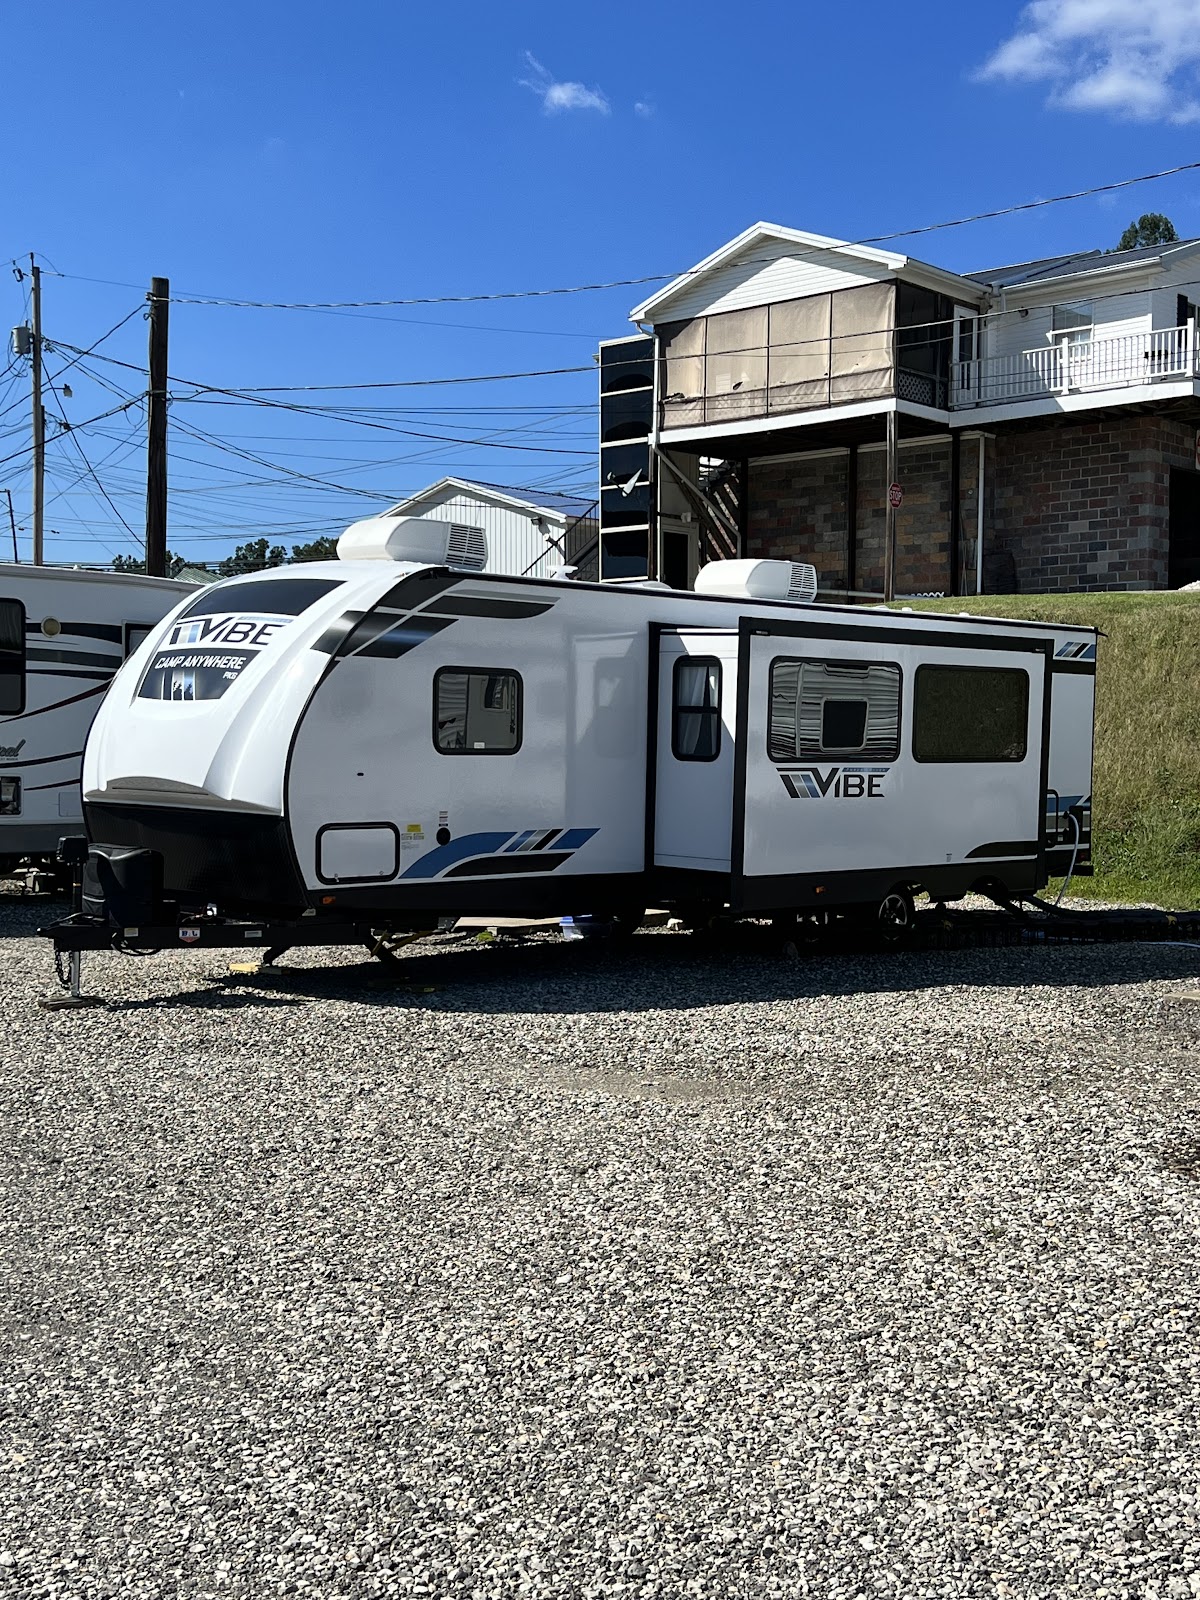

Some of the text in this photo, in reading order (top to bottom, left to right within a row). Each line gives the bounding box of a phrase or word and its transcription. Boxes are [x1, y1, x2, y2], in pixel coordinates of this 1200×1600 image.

[889, 490, 902, 501] STOP
[176, 616, 286, 645] VIBE
[155, 655, 247, 670] CAMP ANYWHERE
[776, 767, 886, 798] VIBE
